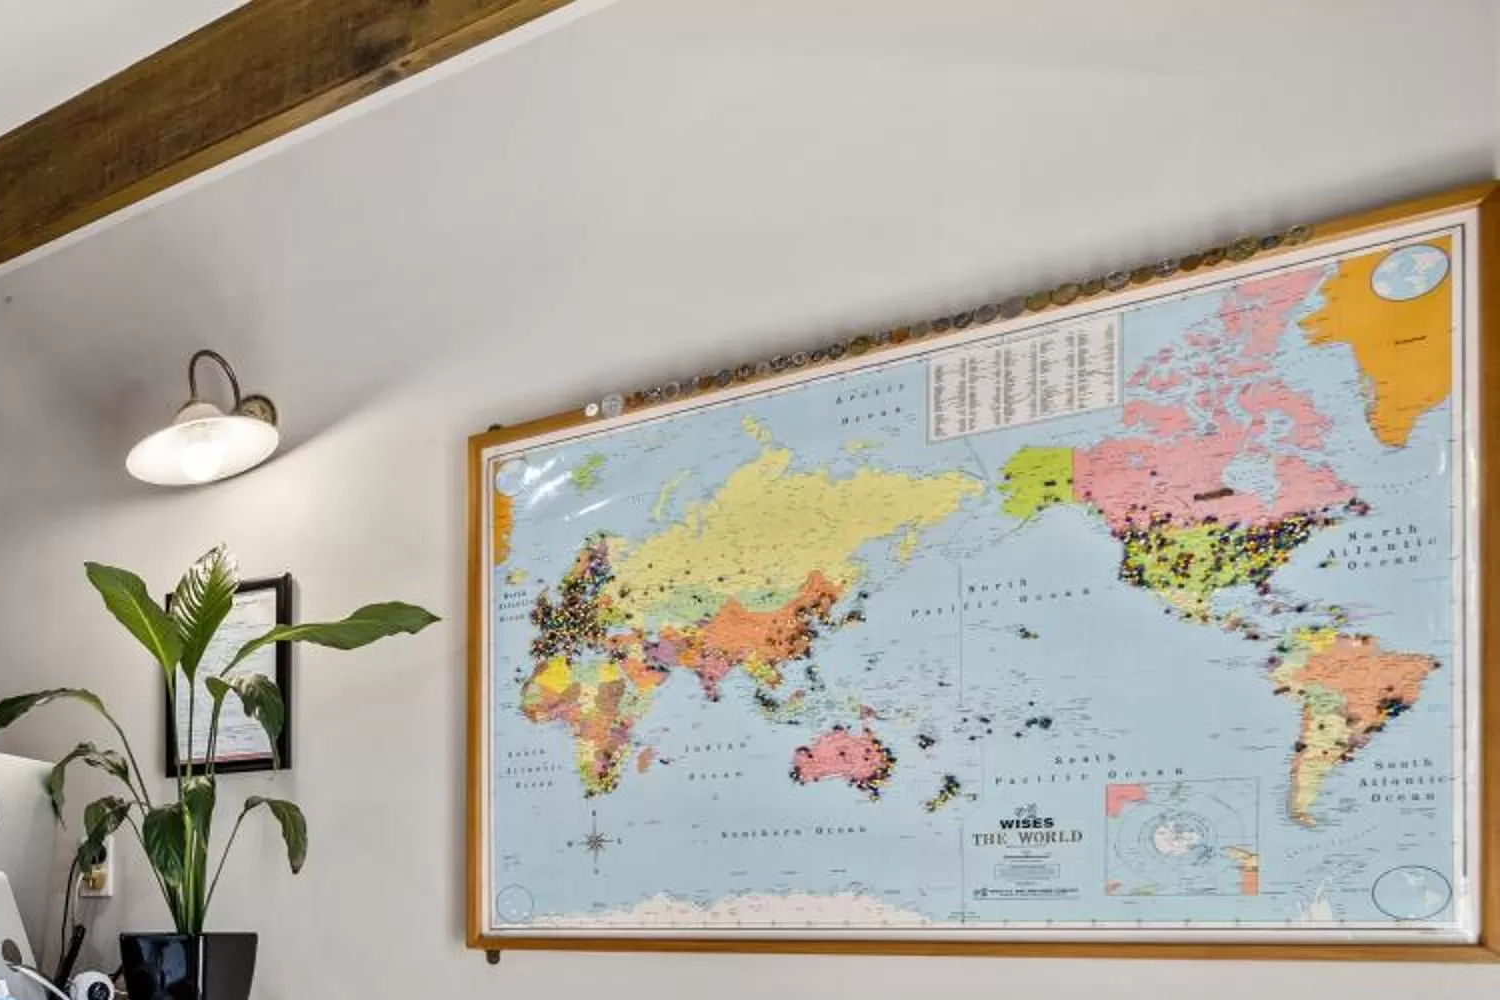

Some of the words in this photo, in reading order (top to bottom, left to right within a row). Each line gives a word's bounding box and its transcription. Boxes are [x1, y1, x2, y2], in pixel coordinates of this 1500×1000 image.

[999, 817, 1055, 830] WISES
[972, 832, 1008, 847] THE
[1018, 830, 1084, 845] WORLD
